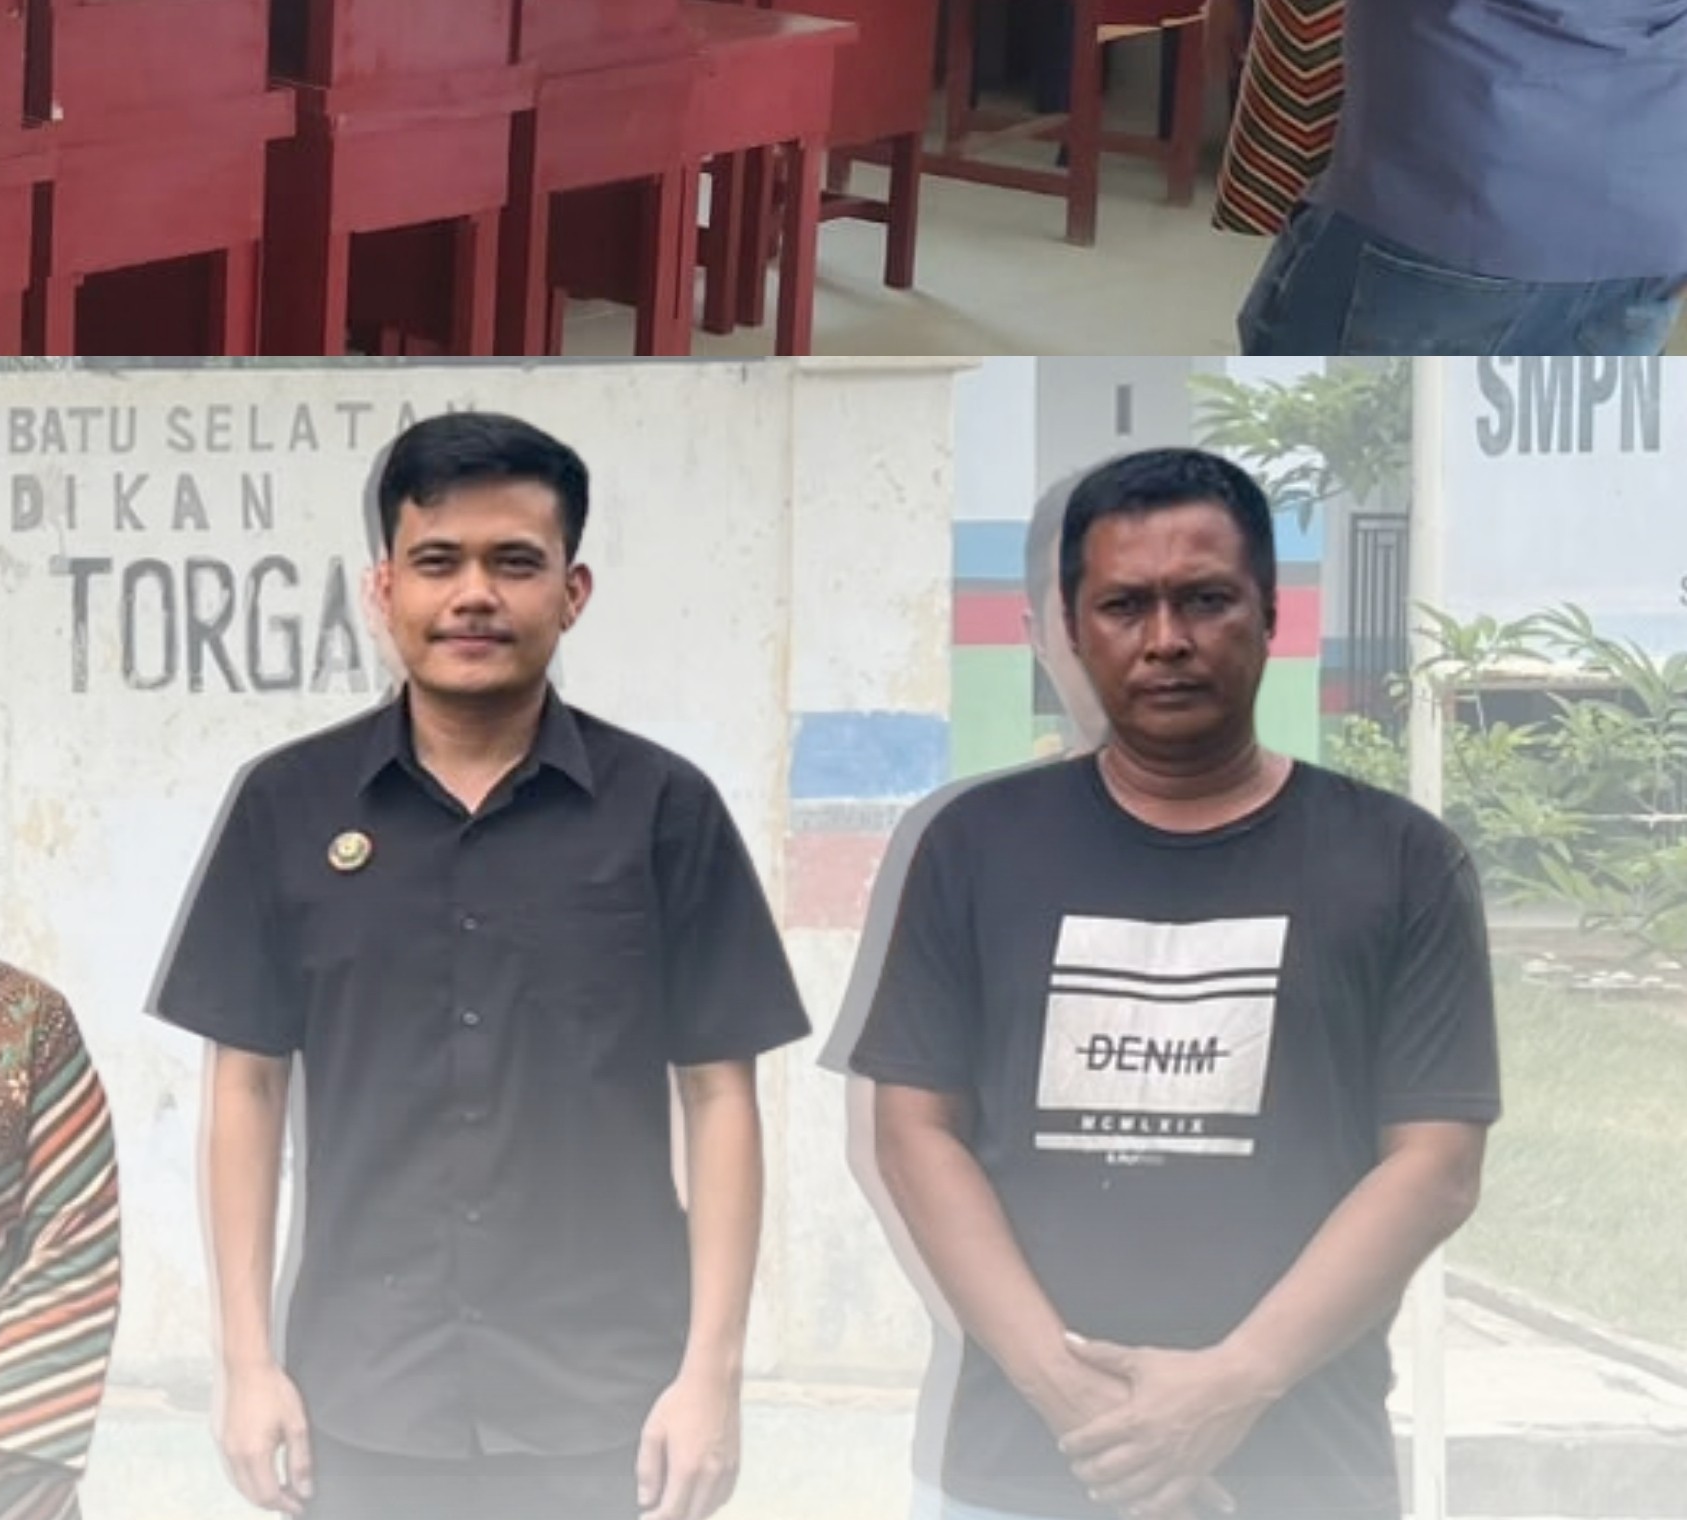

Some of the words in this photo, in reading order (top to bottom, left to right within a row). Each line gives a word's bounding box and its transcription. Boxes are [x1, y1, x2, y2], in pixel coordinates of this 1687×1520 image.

[1476, 356, 1660, 457] SMPN
[50, 555, 388, 693] TORGA
[1085, 1034, 1218, 1074] DENIM
